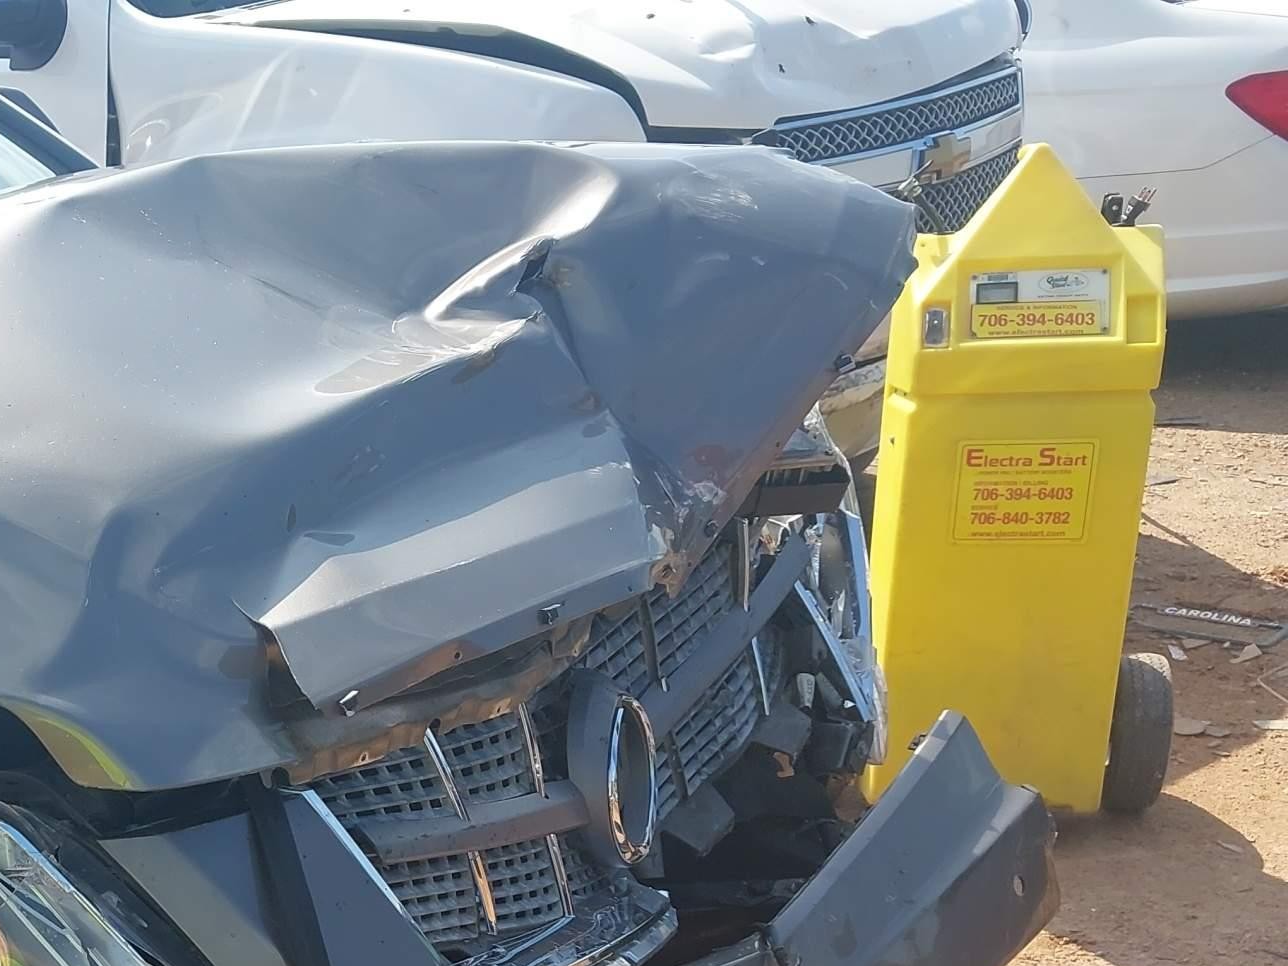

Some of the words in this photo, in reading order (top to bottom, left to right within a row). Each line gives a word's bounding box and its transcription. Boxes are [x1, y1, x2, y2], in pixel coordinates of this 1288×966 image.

[977, 312, 1096, 327] 706-394-6403
[966, 448, 1033, 468] Electra
[1038, 447, 1089, 467] Start
[972, 487, 1074, 501] 706-394-6403
[970, 511, 1072, 525] 706-840-3782
[1164, 607, 1252, 626] CAROLINA
